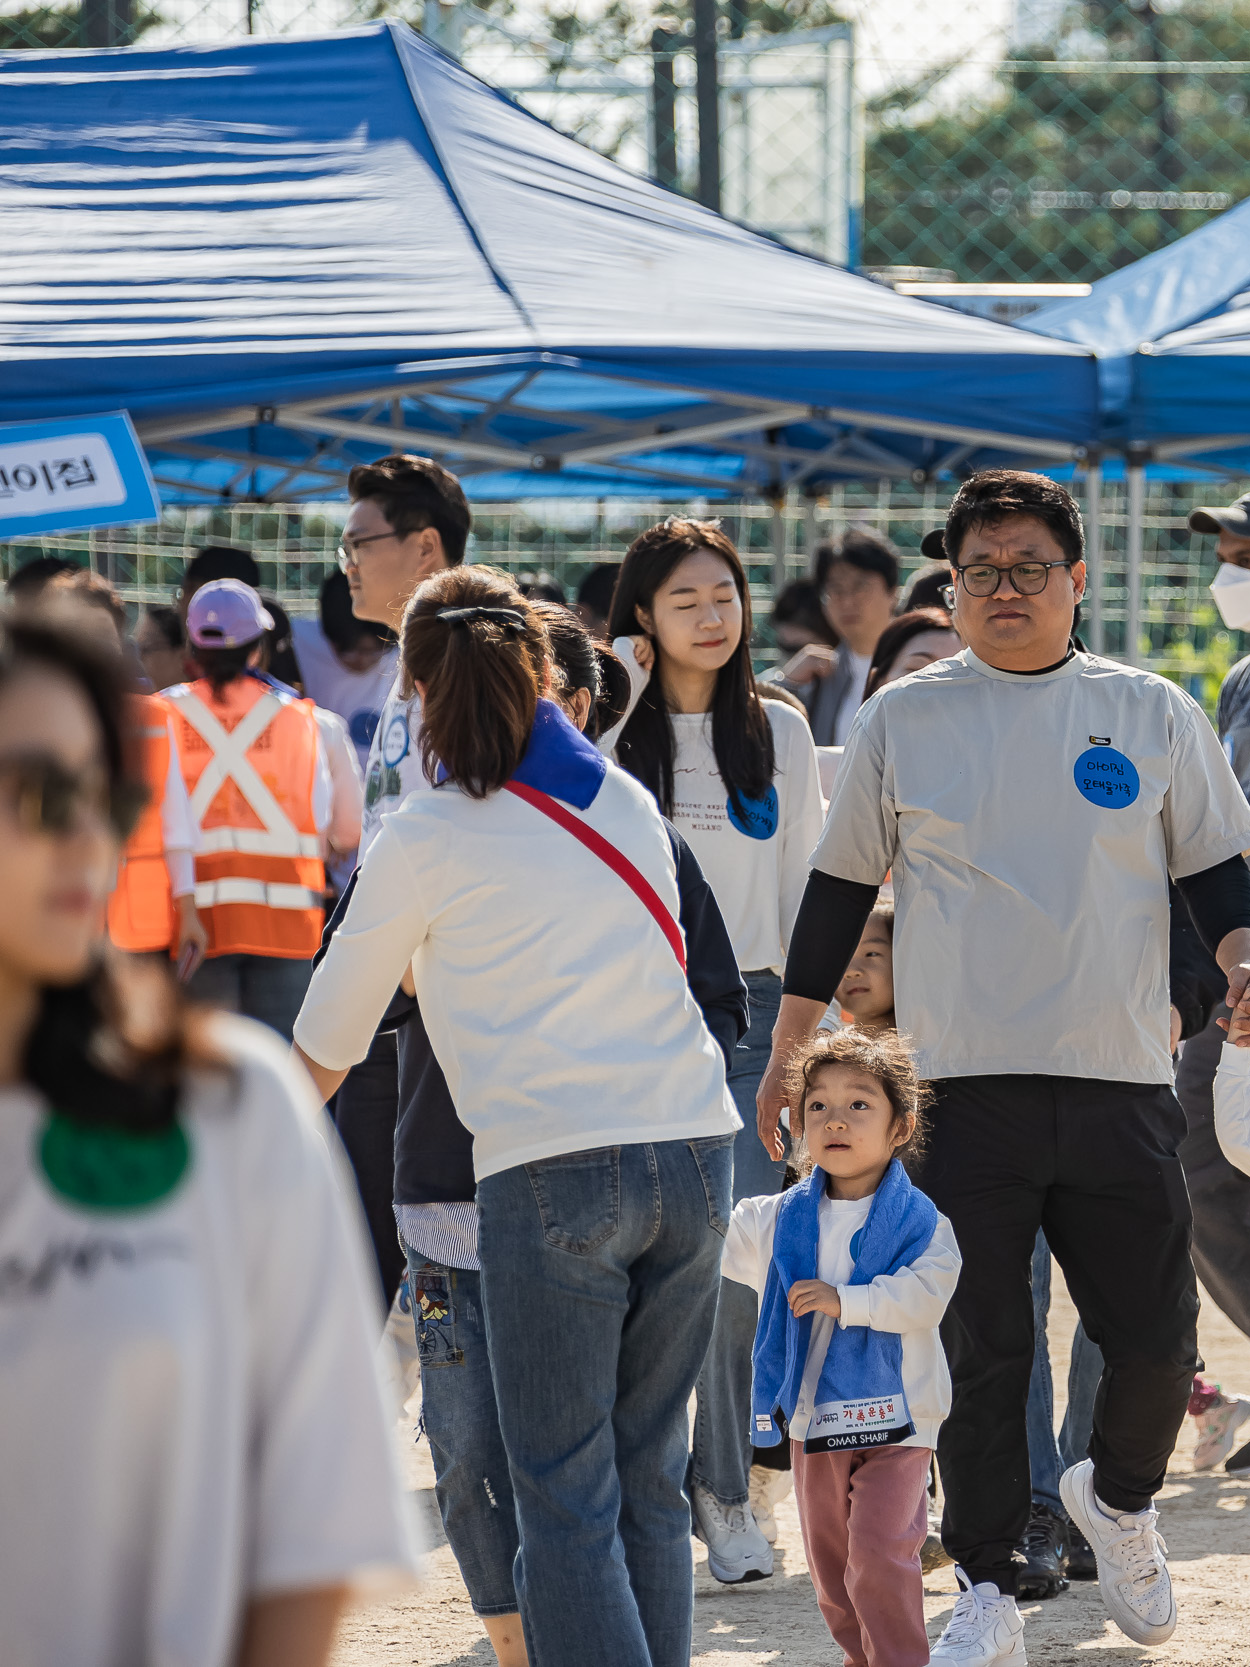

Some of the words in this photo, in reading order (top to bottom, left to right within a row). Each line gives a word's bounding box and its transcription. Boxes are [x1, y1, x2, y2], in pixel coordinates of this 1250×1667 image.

[691, 823, 722, 831] MILANO
[827, 1436, 858, 1447] OMAR
[859, 1432, 889, 1444] SHARIF
